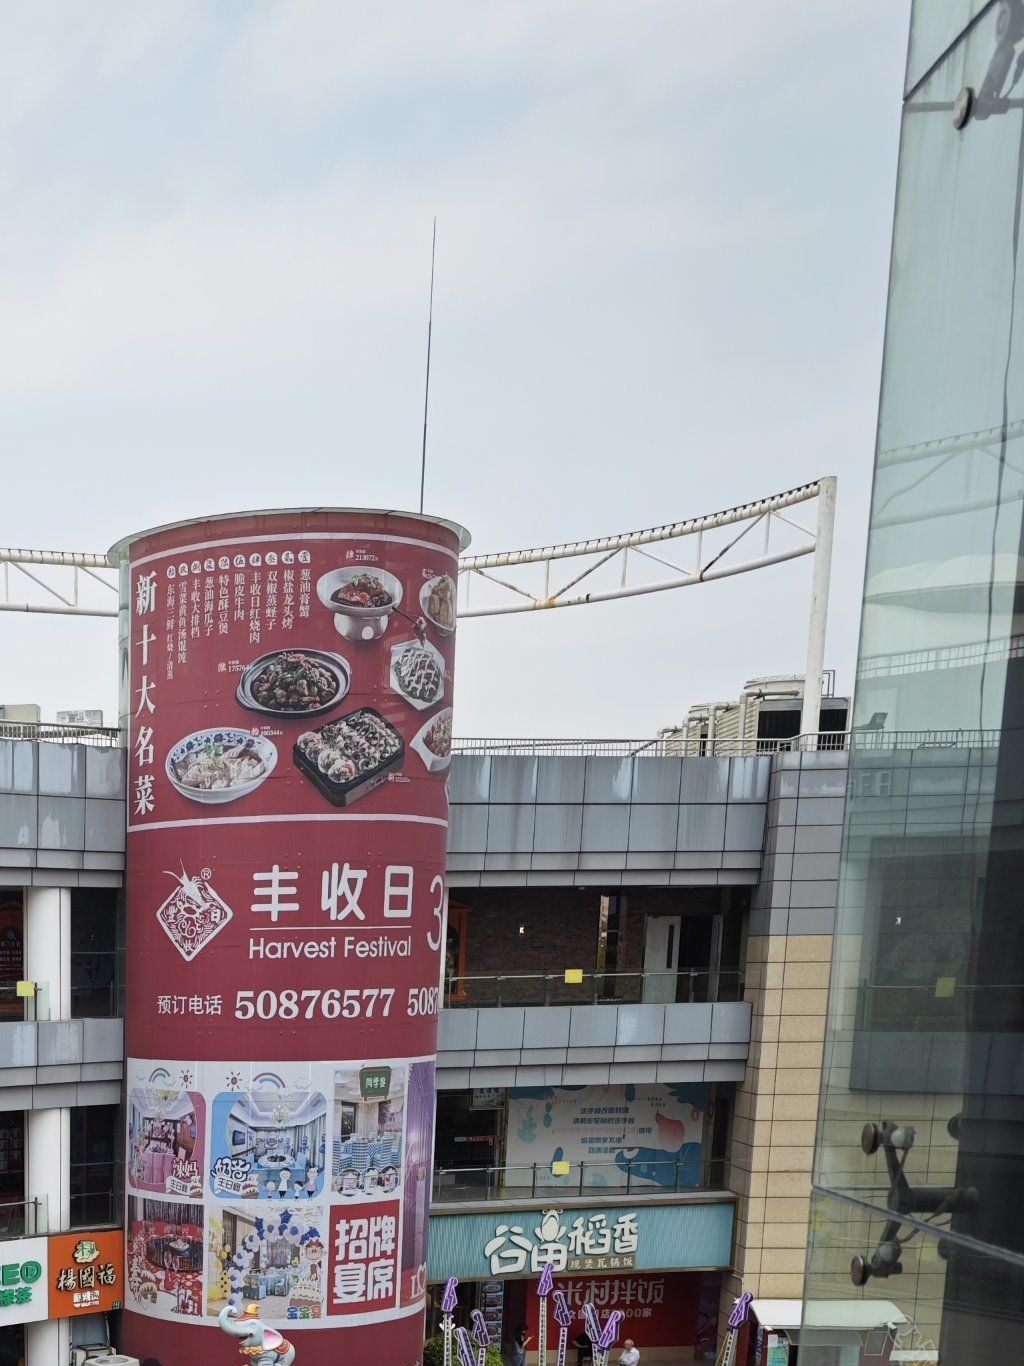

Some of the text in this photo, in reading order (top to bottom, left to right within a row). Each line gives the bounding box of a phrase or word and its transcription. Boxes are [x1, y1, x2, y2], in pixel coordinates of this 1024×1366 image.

[234, 572, 245, 621] 脆皮牛肉
[249, 571, 262, 643] 丰收日红烧肉
[134, 571, 157, 816] 新十大名菜
[250, 862, 415, 922] 丰收日
[249, 935, 412, 959] Harvest Festival
[157, 995, 223, 1016] 预订电话
[234, 988, 396, 1020] 50876577
[335, 1214, 396, 1261] 招牌
[58, 1263, 116, 1291] 楊國福
[333, 1258, 395, 1304] 宴席
[558, 1279, 665, 1306] 米村拌饭
